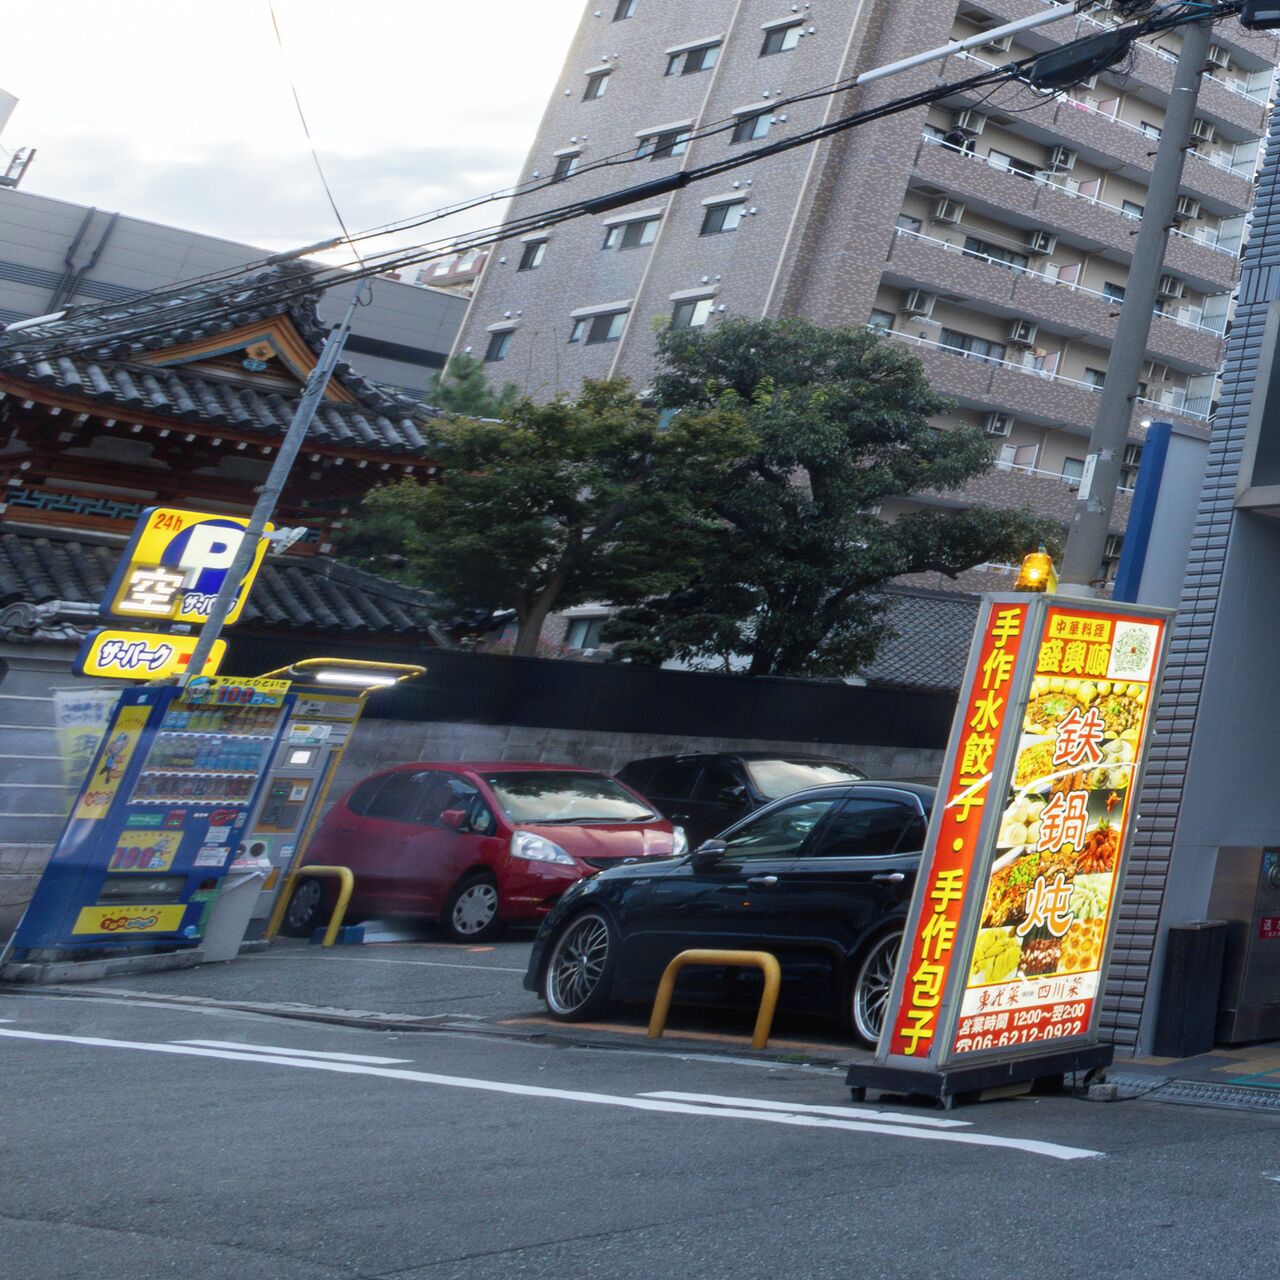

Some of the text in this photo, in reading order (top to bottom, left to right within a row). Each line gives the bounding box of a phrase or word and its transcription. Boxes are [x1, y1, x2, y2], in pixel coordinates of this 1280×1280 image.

[153, 513, 183, 531] 24h
[179, 524, 246, 589] P
[118, 567, 184, 614] 空
[1056, 619, 1106, 638] 中華料理
[98, 640, 172, 670] ザ・パーク
[958, 1012, 1009, 1036] 営業時間
